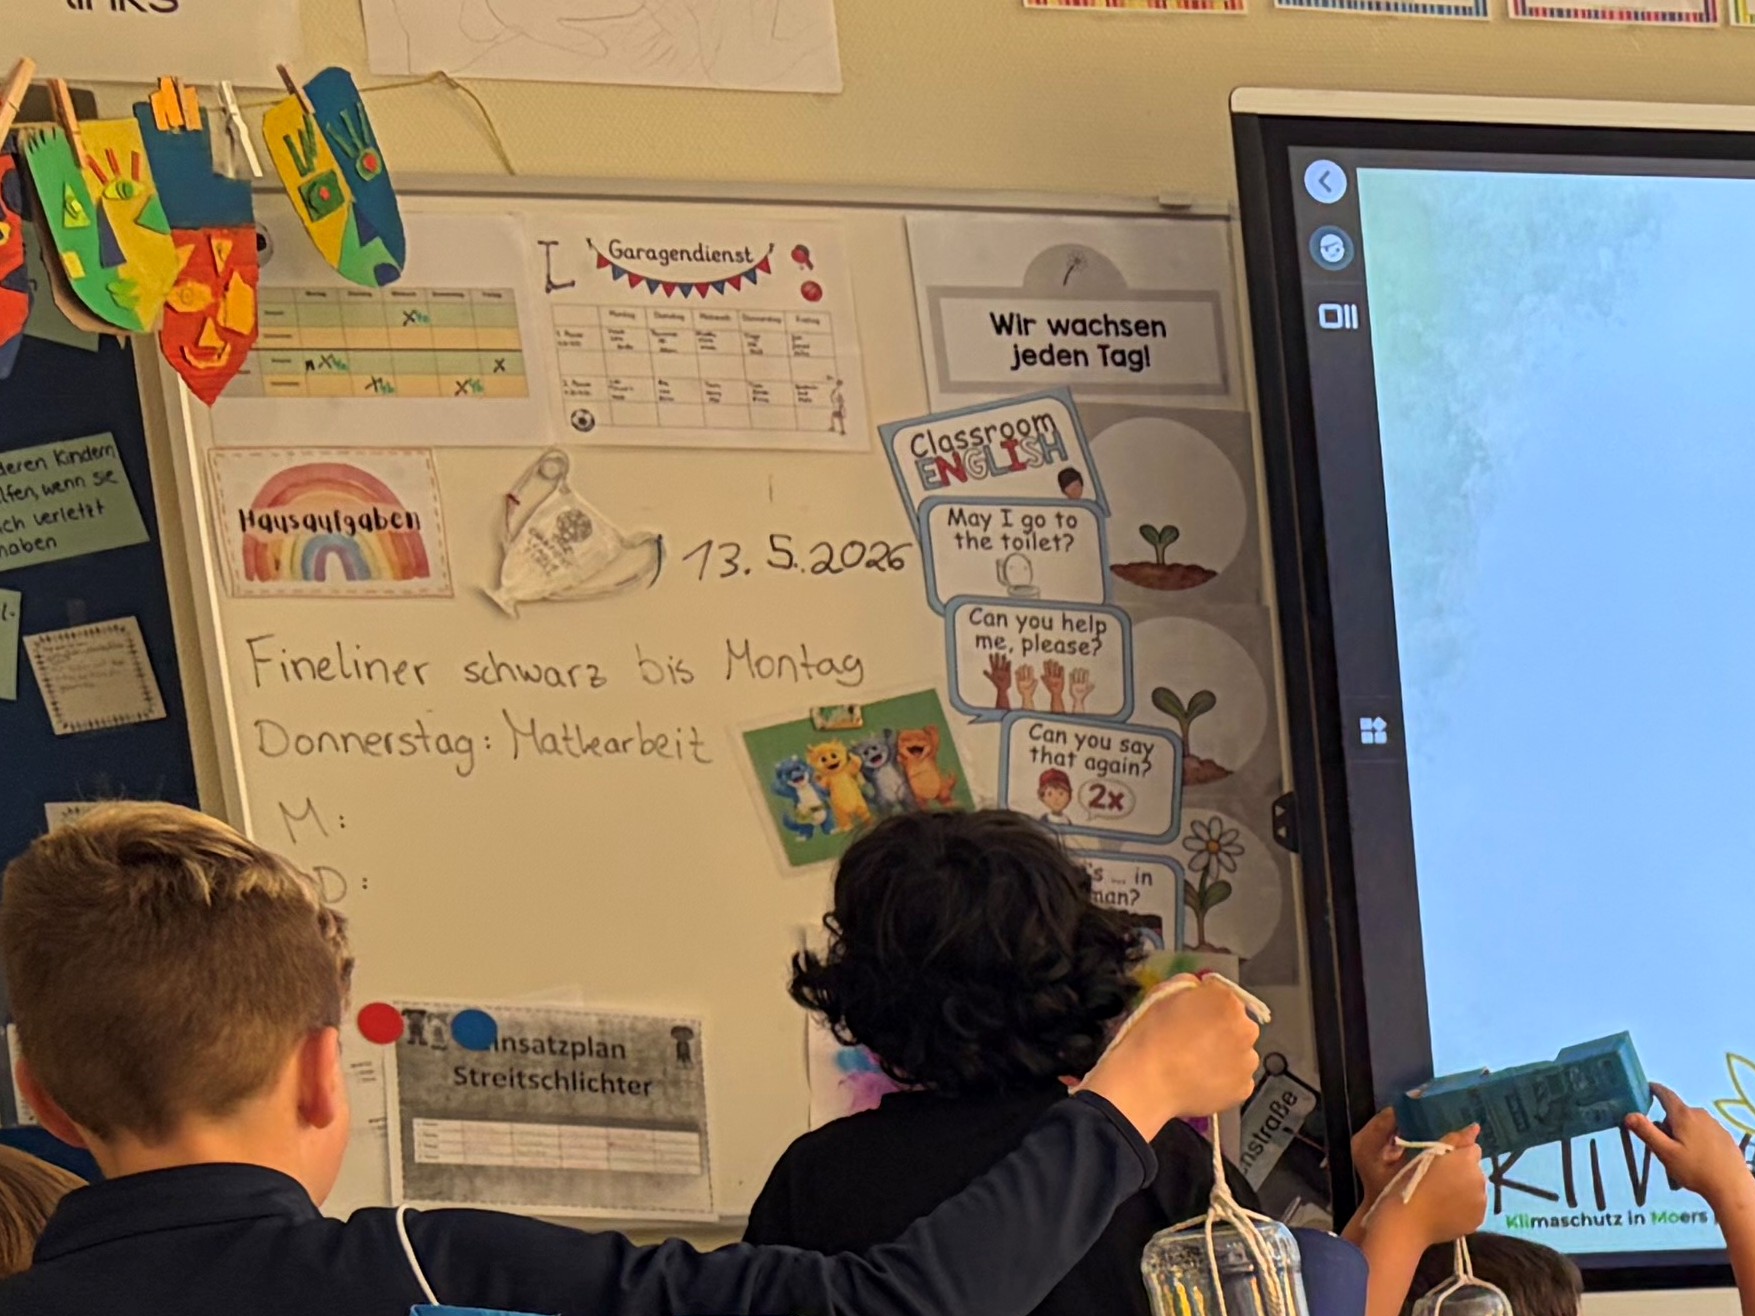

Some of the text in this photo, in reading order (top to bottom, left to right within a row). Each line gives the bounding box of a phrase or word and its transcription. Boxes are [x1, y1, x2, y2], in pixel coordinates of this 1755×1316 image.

[608, 239, 755, 266] Garagendienst
[990, 311, 1167, 338] Wir wachsen
[1010, 343, 1151, 372] jeden Tag!
[910, 412, 1059, 459] Classroom
[53, 443, 118, 468] Kindern
[915, 431, 1069, 491] ENGLISH
[42, 476, 86, 498] wenn
[93, 469, 119, 486] sie
[33, 499, 105, 526] verletzt
[238, 507, 421, 537] Hausaufgaben
[947, 507, 1078, 535] May I go to
[955, 532, 1075, 553] the toilet?
[682, 537, 751, 582] 13.
[969, 607, 1107, 637] Can you help
[975, 633, 1102, 658] me, please?
[246, 634, 866, 689] Fineliner schwarz bis Montag
[253, 708, 714, 779] Donnerstag: Mathearbeit
[1028, 722, 1156, 765] Can you say
[1029, 746, 1153, 778] that again?
[1087, 783, 1125, 812] 2x
[277, 798, 348, 845] M:
[1134, 867, 1154, 887] in
[484, 1035, 627, 1062] insatzplan
[453, 1064, 654, 1098] Streitschlichter
[1505, 1211, 1624, 1231] Klimaschutz
[1628, 1210, 1647, 1228] in
[1651, 1208, 1708, 1225] Moers
